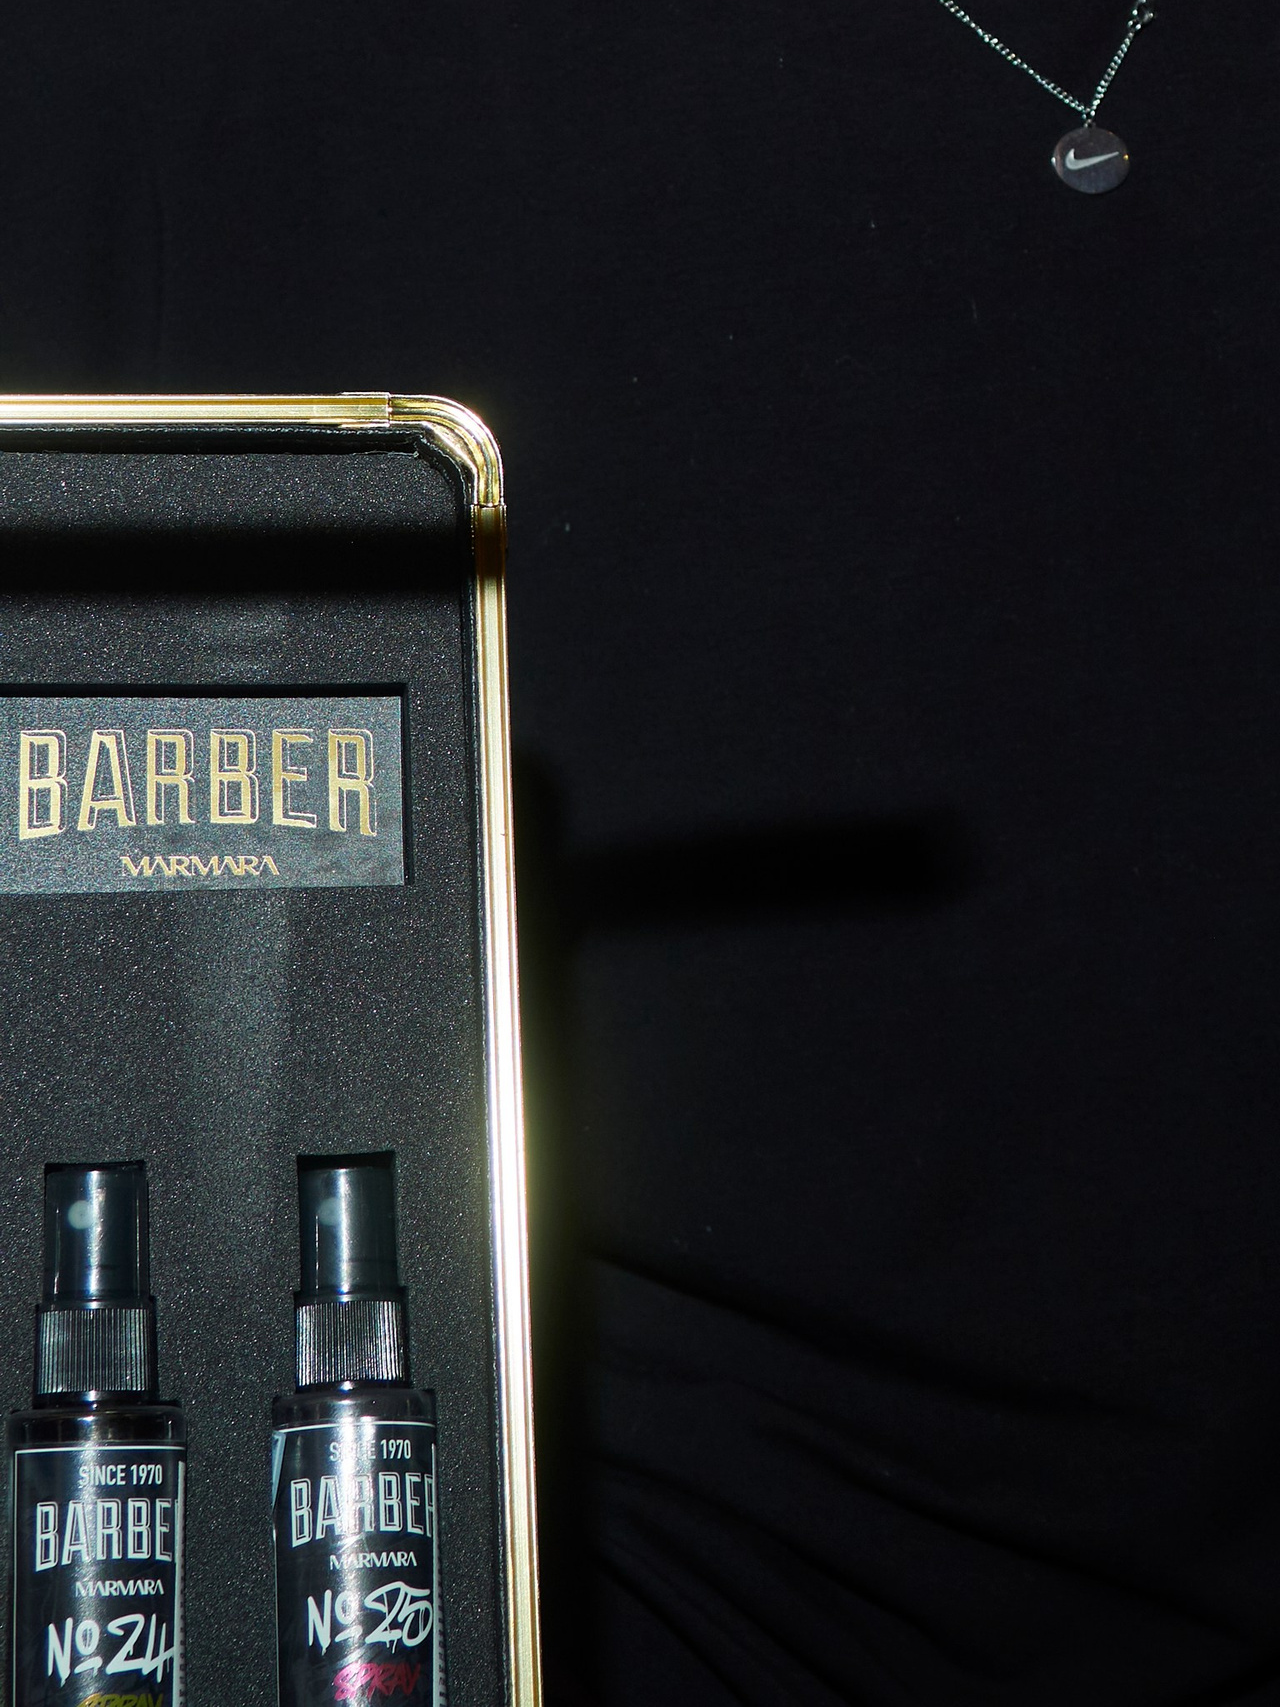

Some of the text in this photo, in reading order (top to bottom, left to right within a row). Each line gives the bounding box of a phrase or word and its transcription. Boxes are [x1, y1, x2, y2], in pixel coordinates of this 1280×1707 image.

[18, 728, 378, 841] BARBER
[120, 855, 279, 876] MARMARA
[380, 1439, 412, 1460] 1970
[79, 1464, 163, 1485] SINCE 1970
[36, 1497, 178, 1572] BARBE
[329, 1551, 417, 1571] MARMARA
[75, 1579, 164, 1597] MARMARA
[332, 1661, 421, 1703] SPRAY
